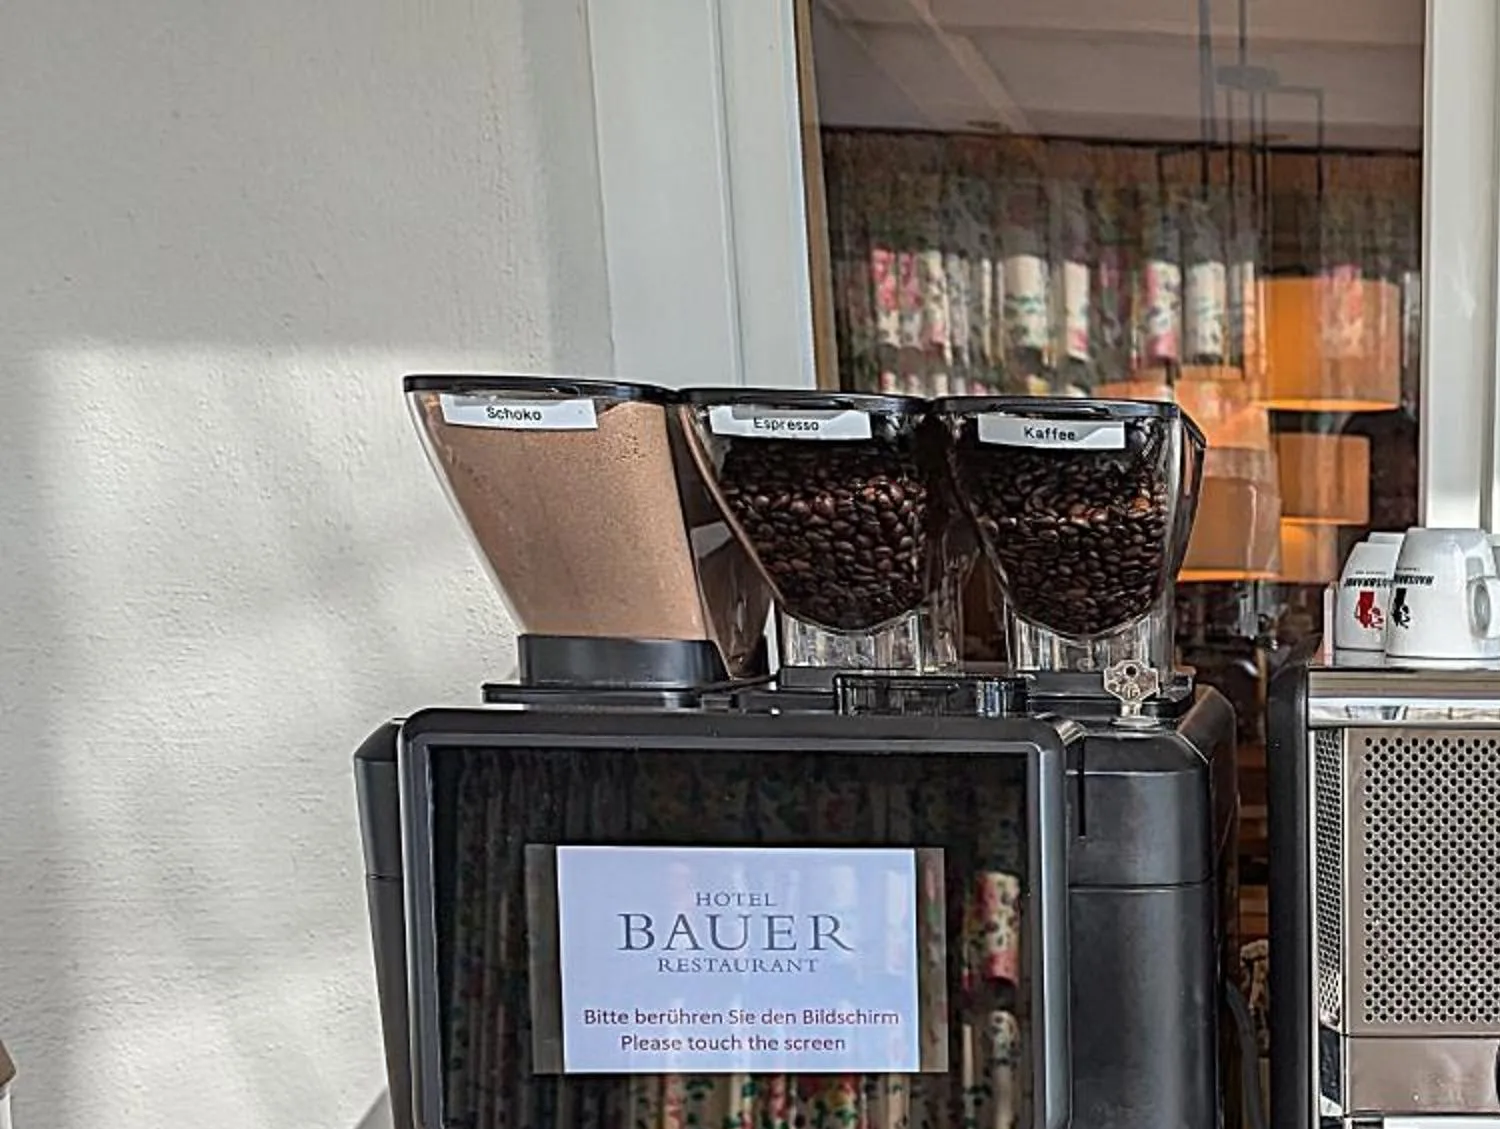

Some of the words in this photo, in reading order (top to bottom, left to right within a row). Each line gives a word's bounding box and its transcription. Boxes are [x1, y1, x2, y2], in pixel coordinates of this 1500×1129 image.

[486, 404, 543, 422] Schoko
[752, 415, 821, 433] Espresso
[1024, 426, 1076, 442] Kaffee
[696, 892, 777, 907] HOTEL
[618, 913, 854, 951] BAUER
[657, 957, 819, 973] RESTAURANT
[584, 1008, 629, 1026] Bitte
[635, 1008, 723, 1026] berühren
[729, 1008, 756, 1026] Sie
[761, 1008, 797, 1026] den
[803, 1008, 900, 1026] Bildschirm
[621, 1035, 683, 1052] Please
[688, 1035, 743, 1052] touch
[748, 1035, 779, 1052] the
[784, 1039, 846, 1052] screen
